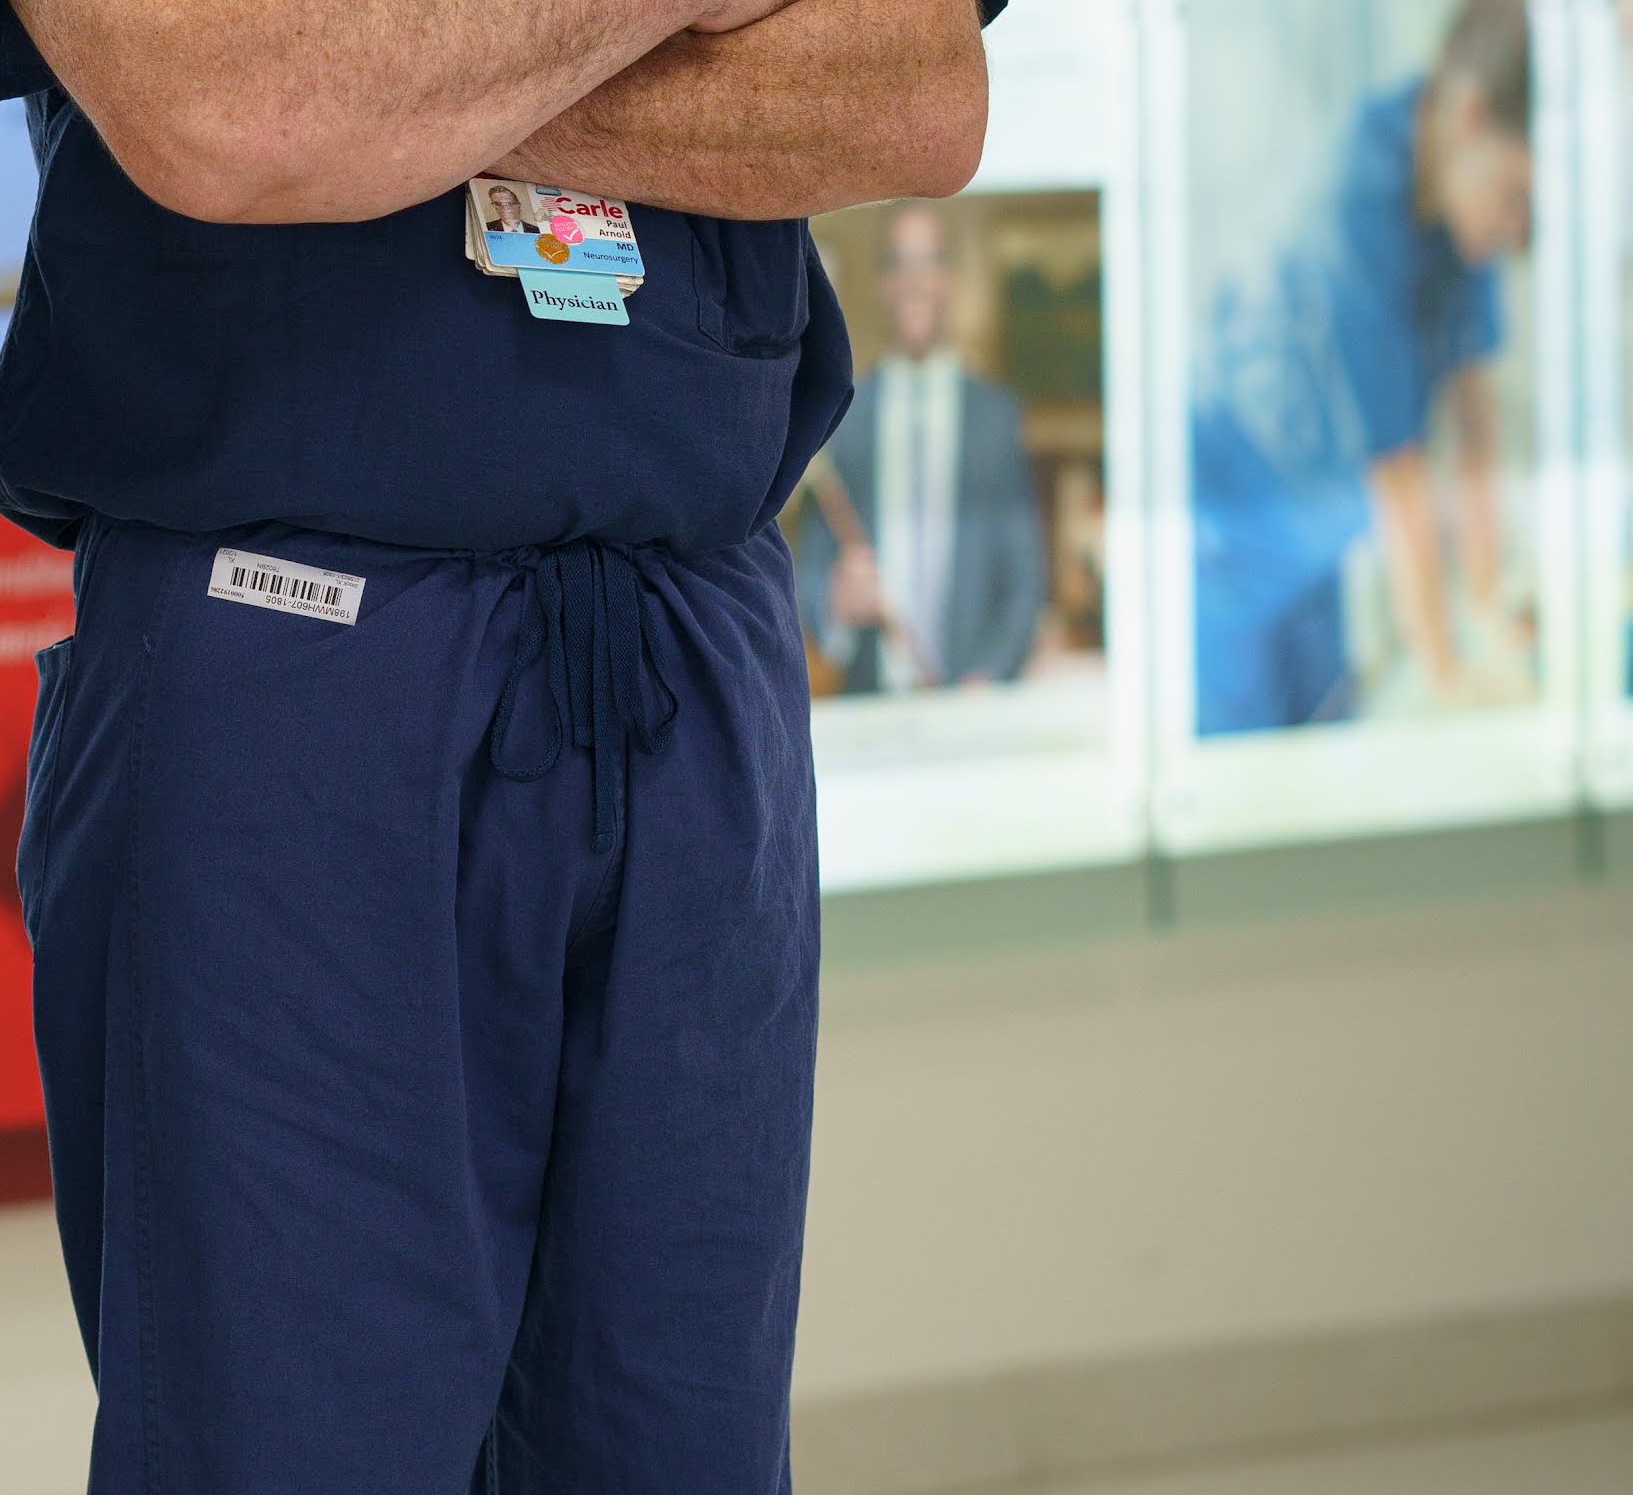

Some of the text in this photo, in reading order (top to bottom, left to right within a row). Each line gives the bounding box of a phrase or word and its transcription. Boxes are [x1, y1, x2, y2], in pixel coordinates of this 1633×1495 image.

[554, 196, 624, 219] Carle
[605, 219, 628, 230] Paul
[598, 229, 632, 240] Arnold
[616, 242, 635, 252] MD
[582, 251, 640, 266] Neurosurgery
[530, 289, 620, 312] Physician
